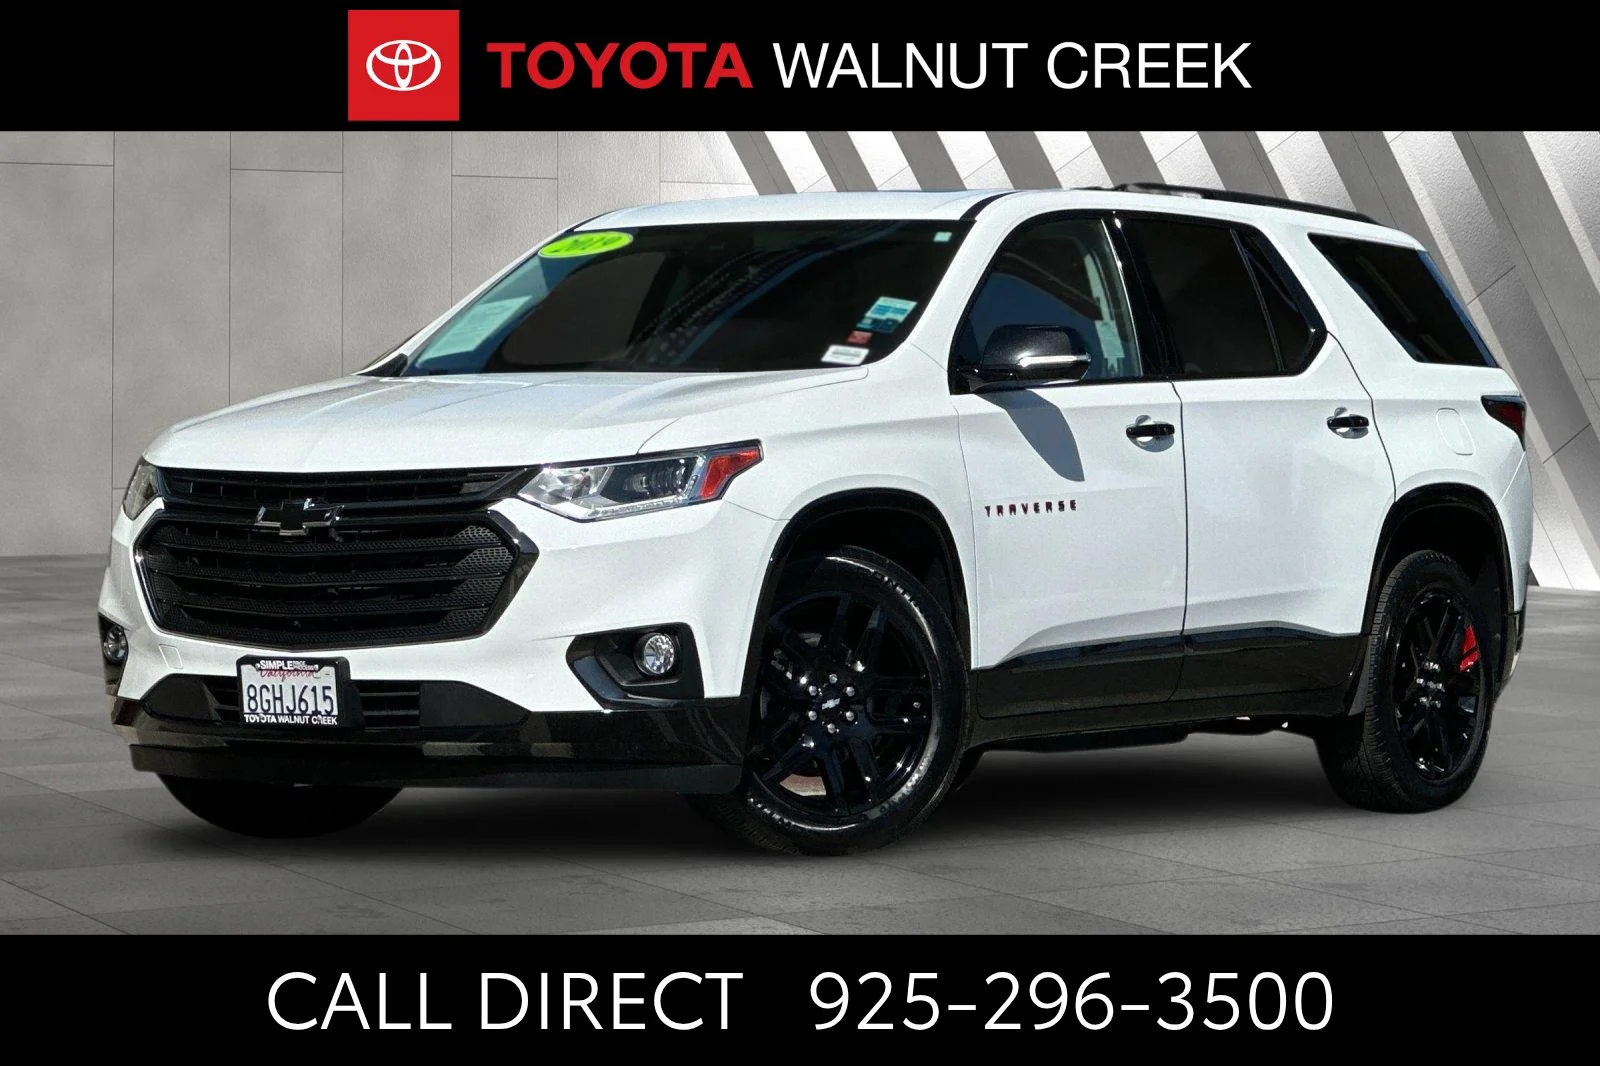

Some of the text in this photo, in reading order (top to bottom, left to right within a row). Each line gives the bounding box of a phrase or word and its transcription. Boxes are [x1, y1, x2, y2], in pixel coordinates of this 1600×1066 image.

[985, 500, 1077, 518] TRAVERSE
[260, 660, 293, 670] SIMPLE
[247, 684, 334, 715] 8GHJ615
[244, 714, 338, 726] TOYOTA WALNUT CREEK
